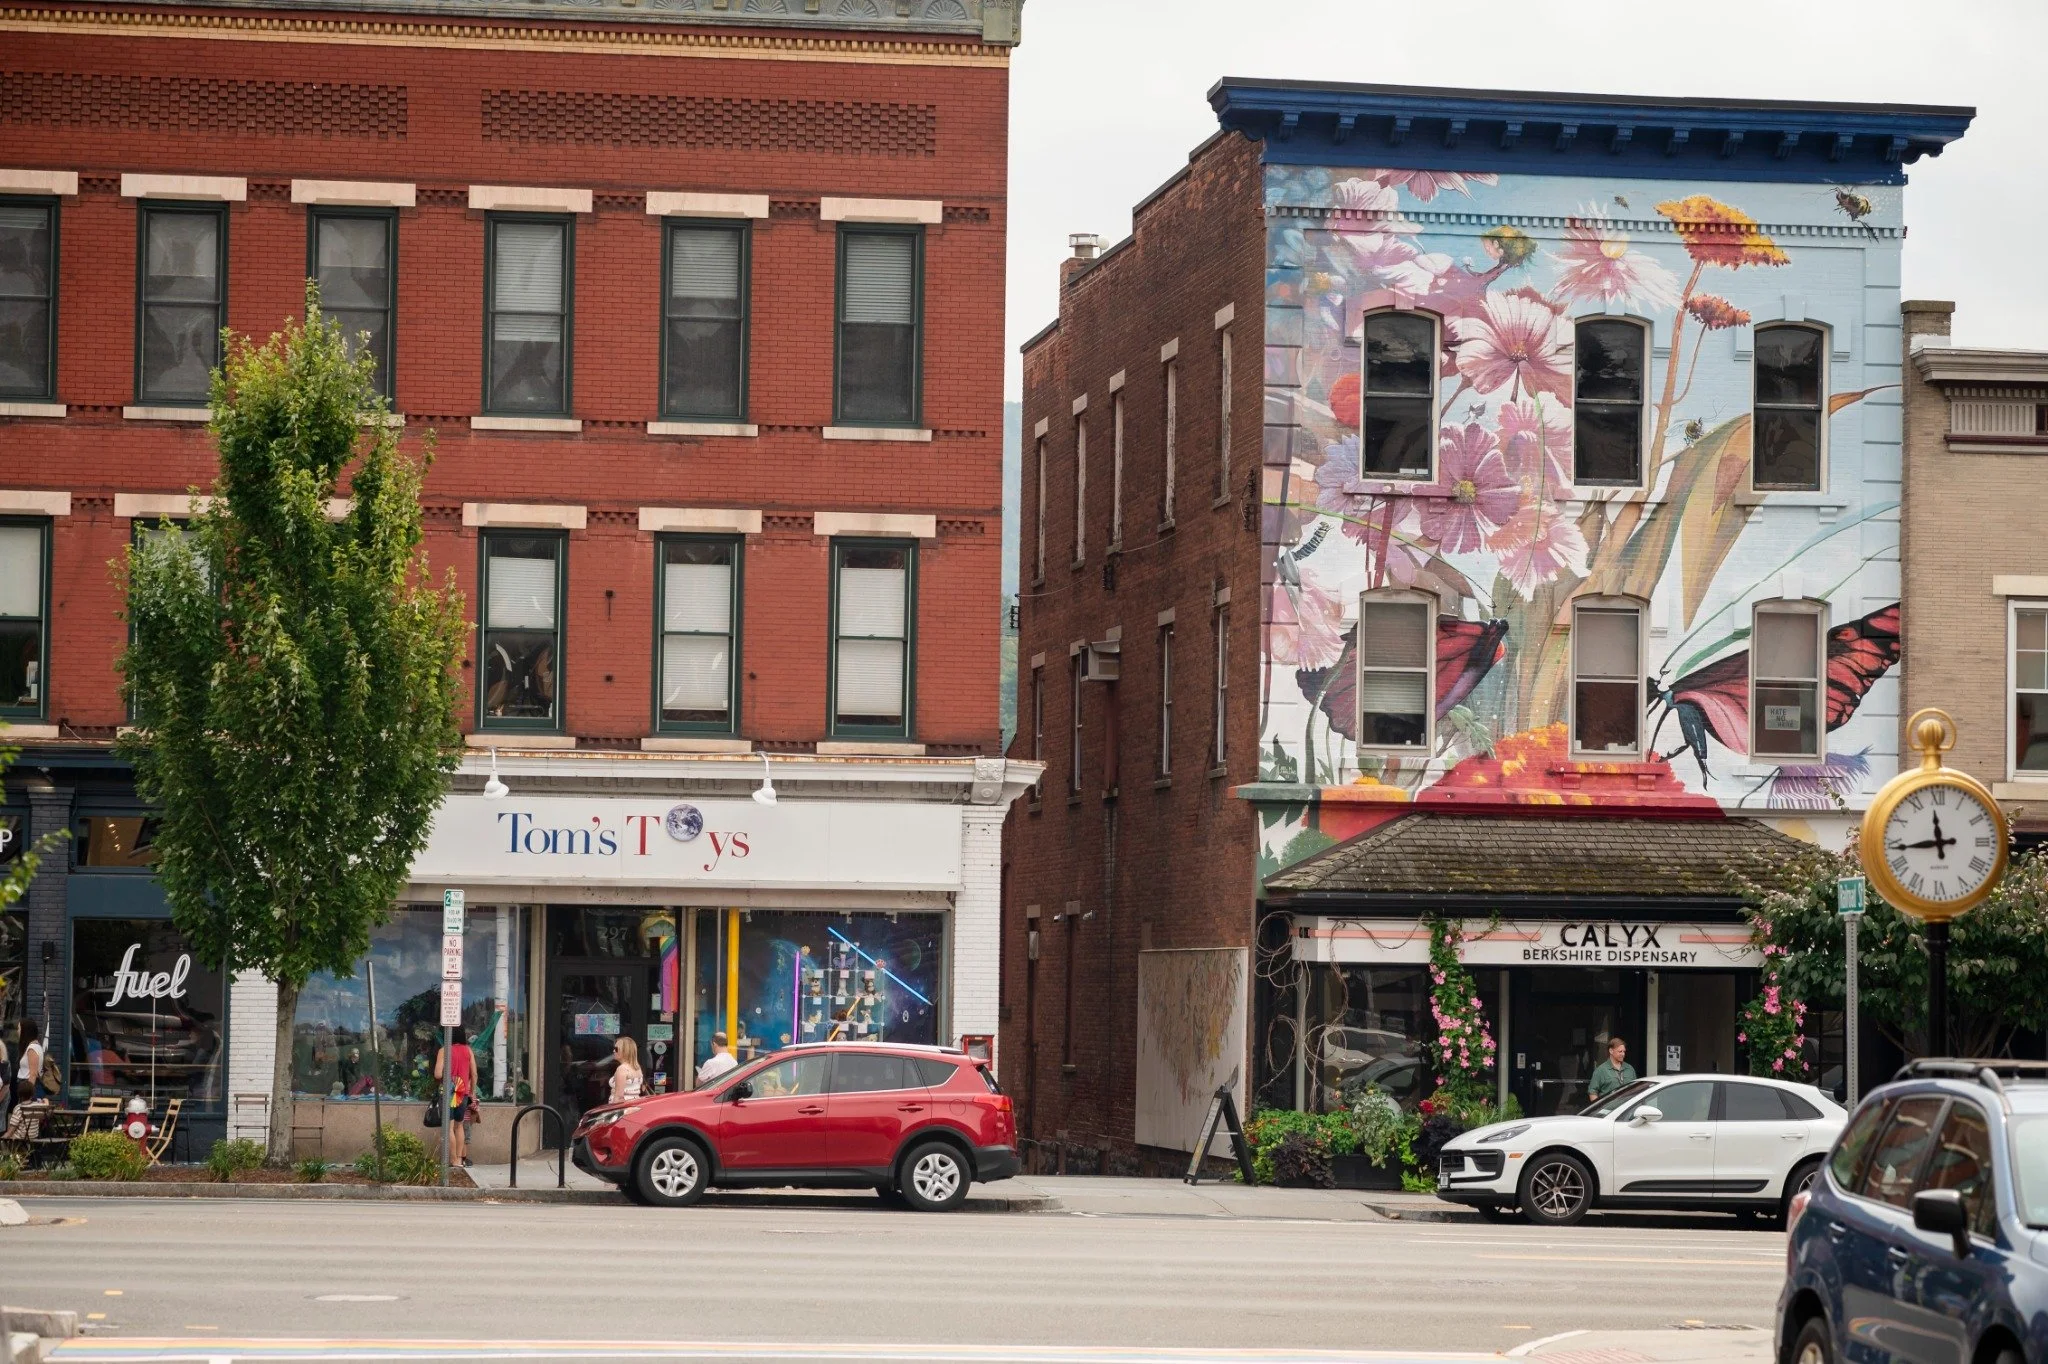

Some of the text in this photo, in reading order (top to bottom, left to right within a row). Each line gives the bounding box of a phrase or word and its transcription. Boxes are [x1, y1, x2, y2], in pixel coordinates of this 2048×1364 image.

[497, 811, 618, 856] Tom's
[449, 939, 457, 948] NO
[1560, 924, 1662, 948] CALYX
[444, 948, 462, 956] PARKING
[1523, 949, 1698, 963] BERKSHIRE DISPENSARY
[106, 943, 191, 1007] fuel
